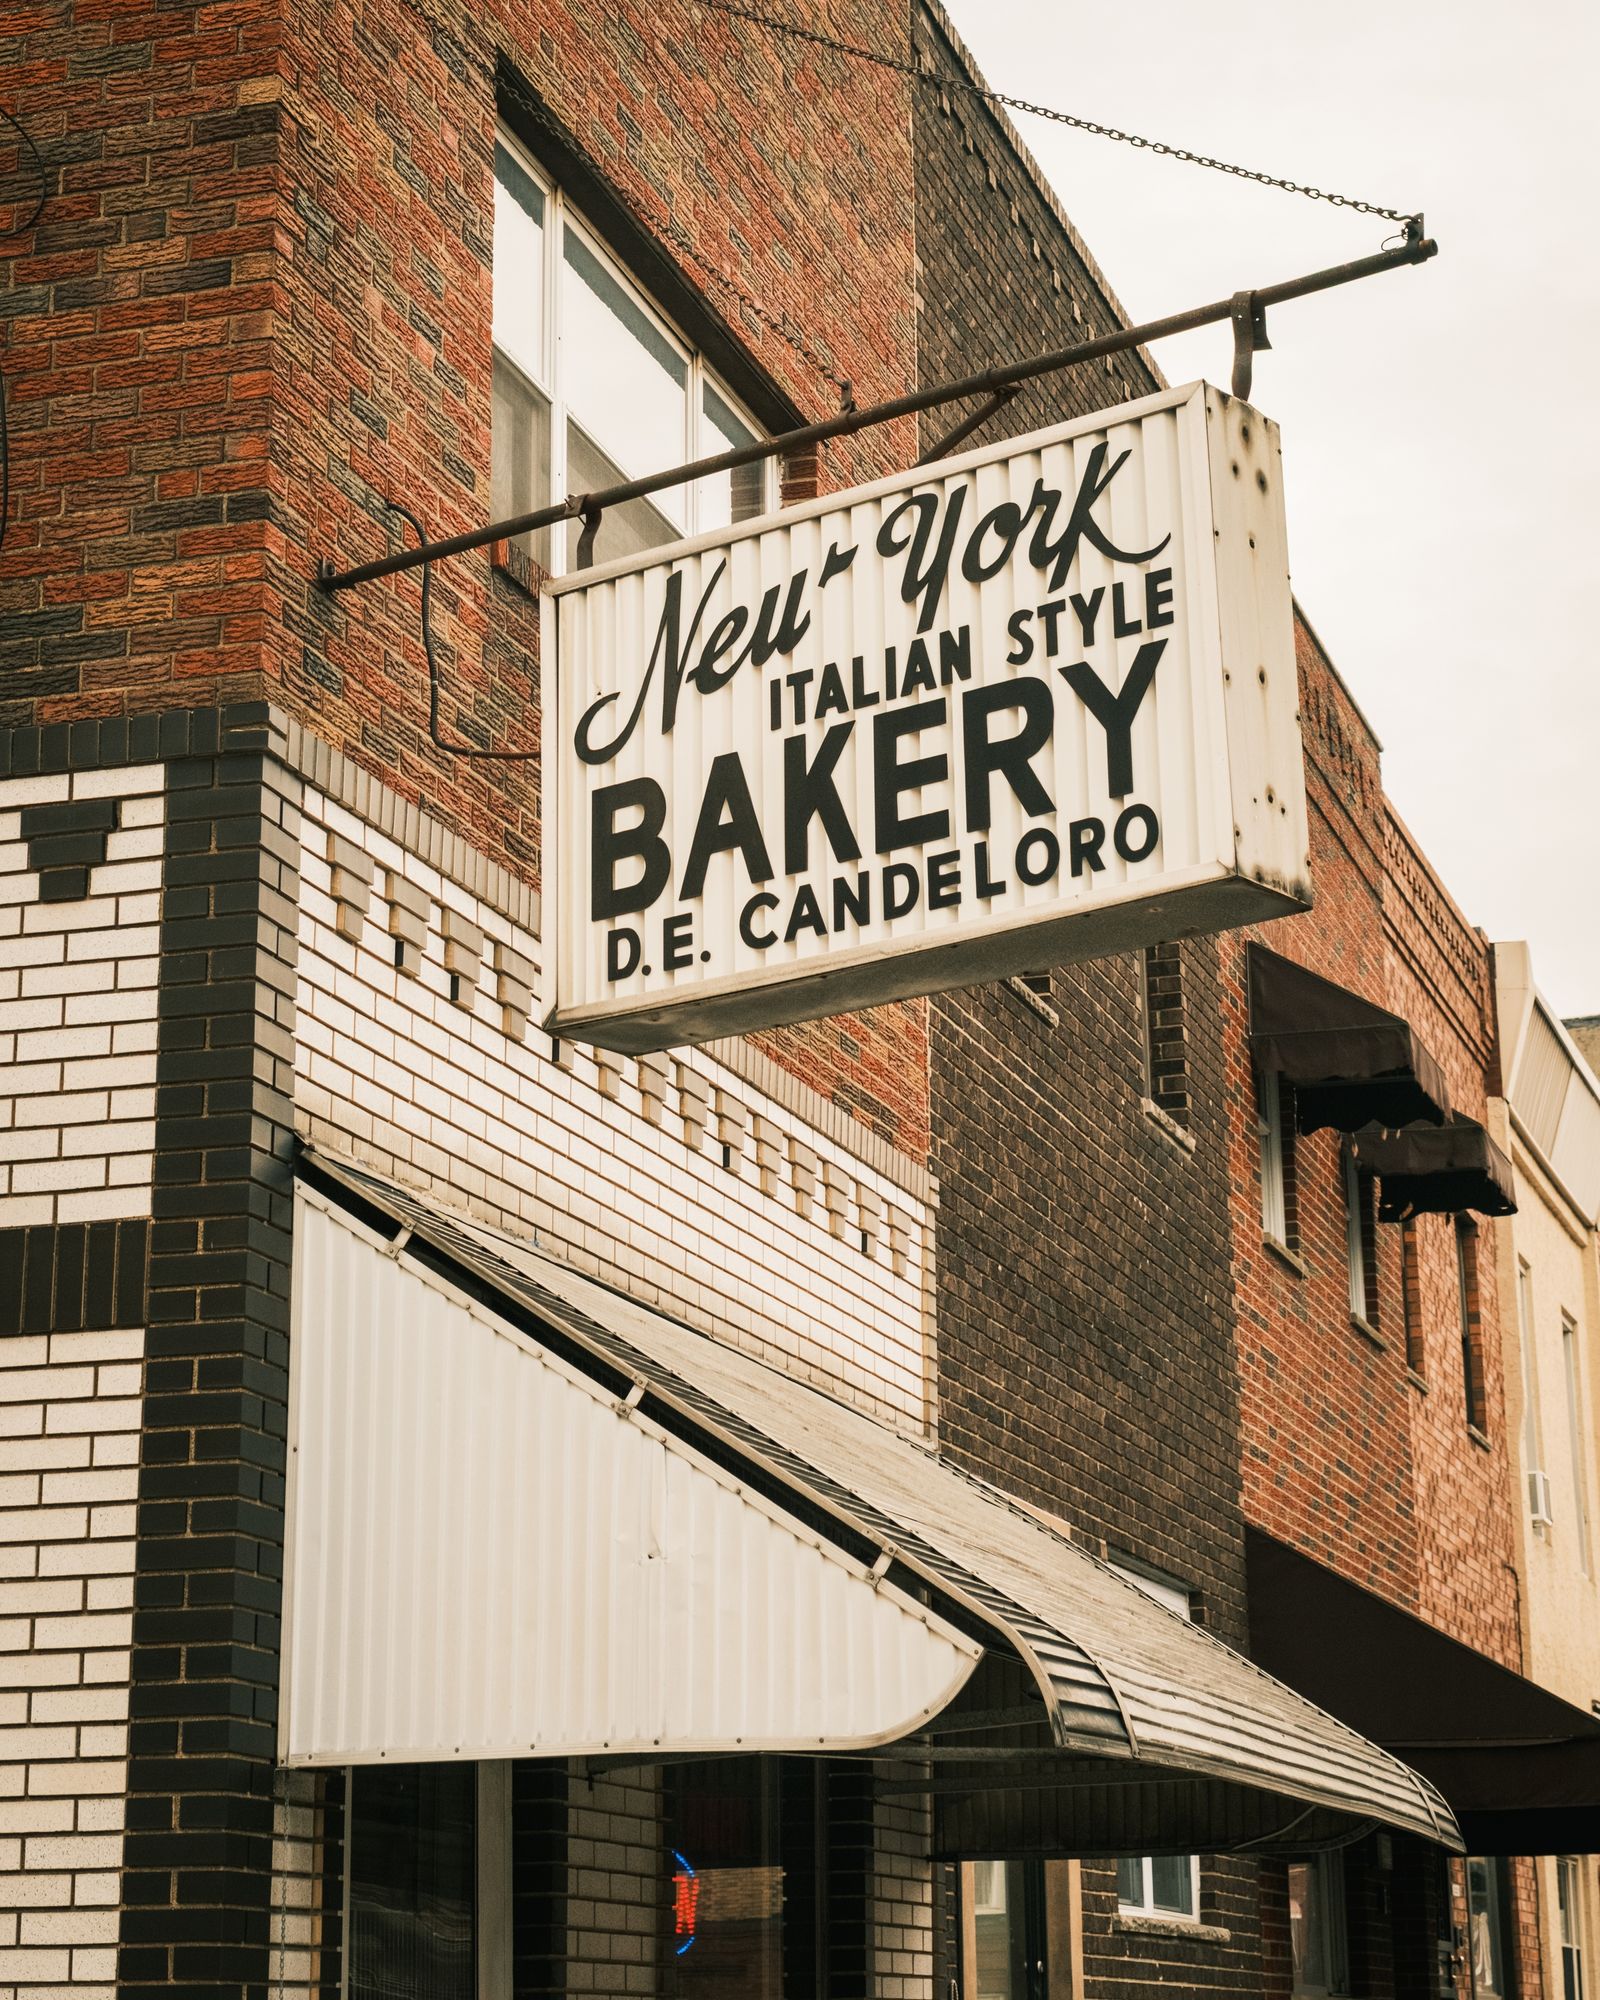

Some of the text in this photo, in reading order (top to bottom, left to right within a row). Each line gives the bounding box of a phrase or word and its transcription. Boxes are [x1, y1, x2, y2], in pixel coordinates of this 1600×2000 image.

[574, 441, 1172, 766] New York
[770, 568, 1175, 732] ITALIAN STYLE
[591, 638, 1169, 923] BAKERY
[607, 804, 1160, 983] D.E. CANDELORO
